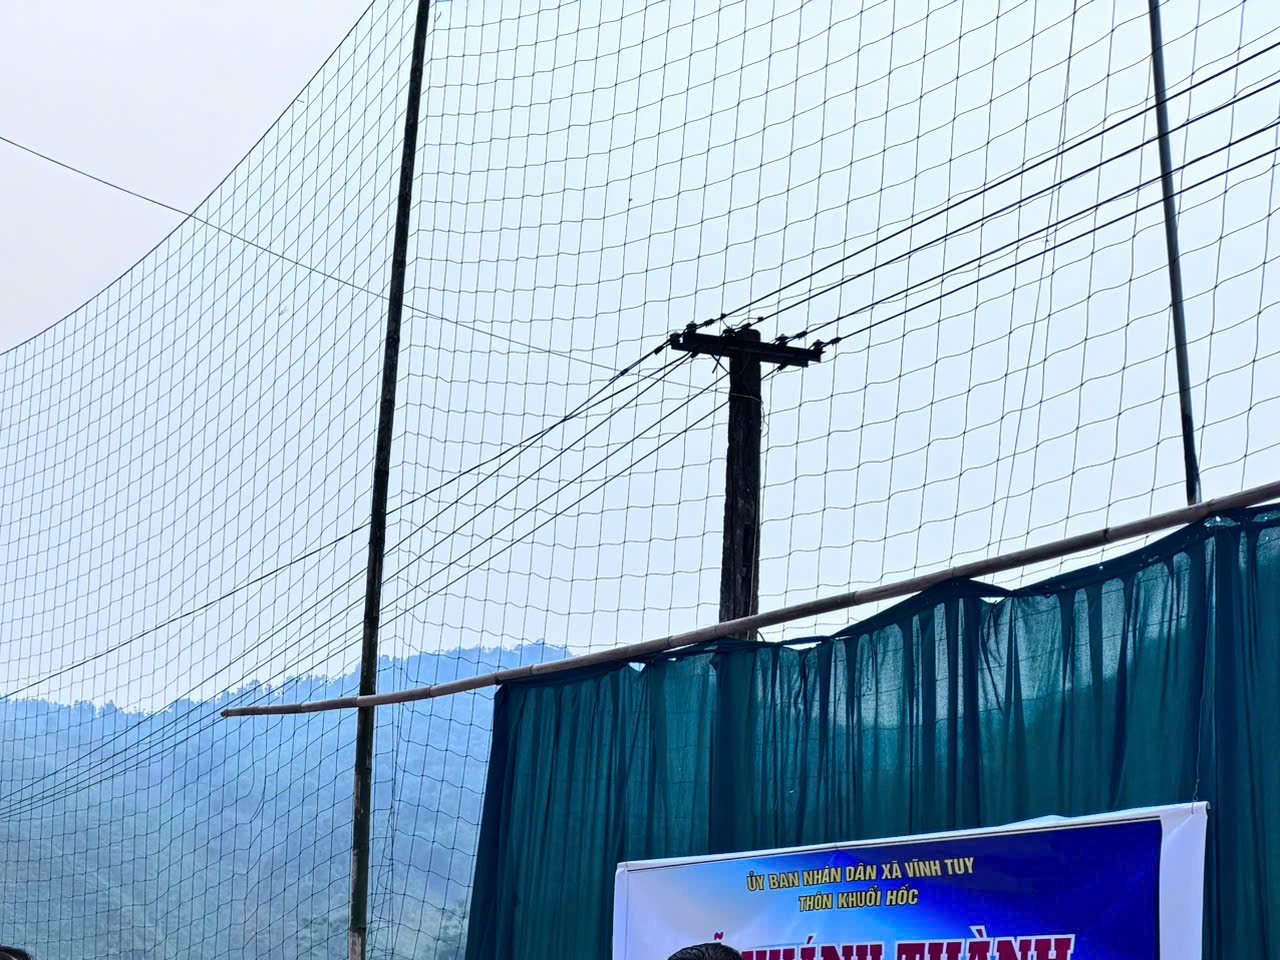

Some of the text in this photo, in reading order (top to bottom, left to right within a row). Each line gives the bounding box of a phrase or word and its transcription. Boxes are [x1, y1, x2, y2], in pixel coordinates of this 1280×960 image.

[746, 857, 974, 891] ỦY BAN NHÂN DÂN XÃ VĨNH TUY
[799, 884, 919, 912] THÔN KHUỔI HỐC
